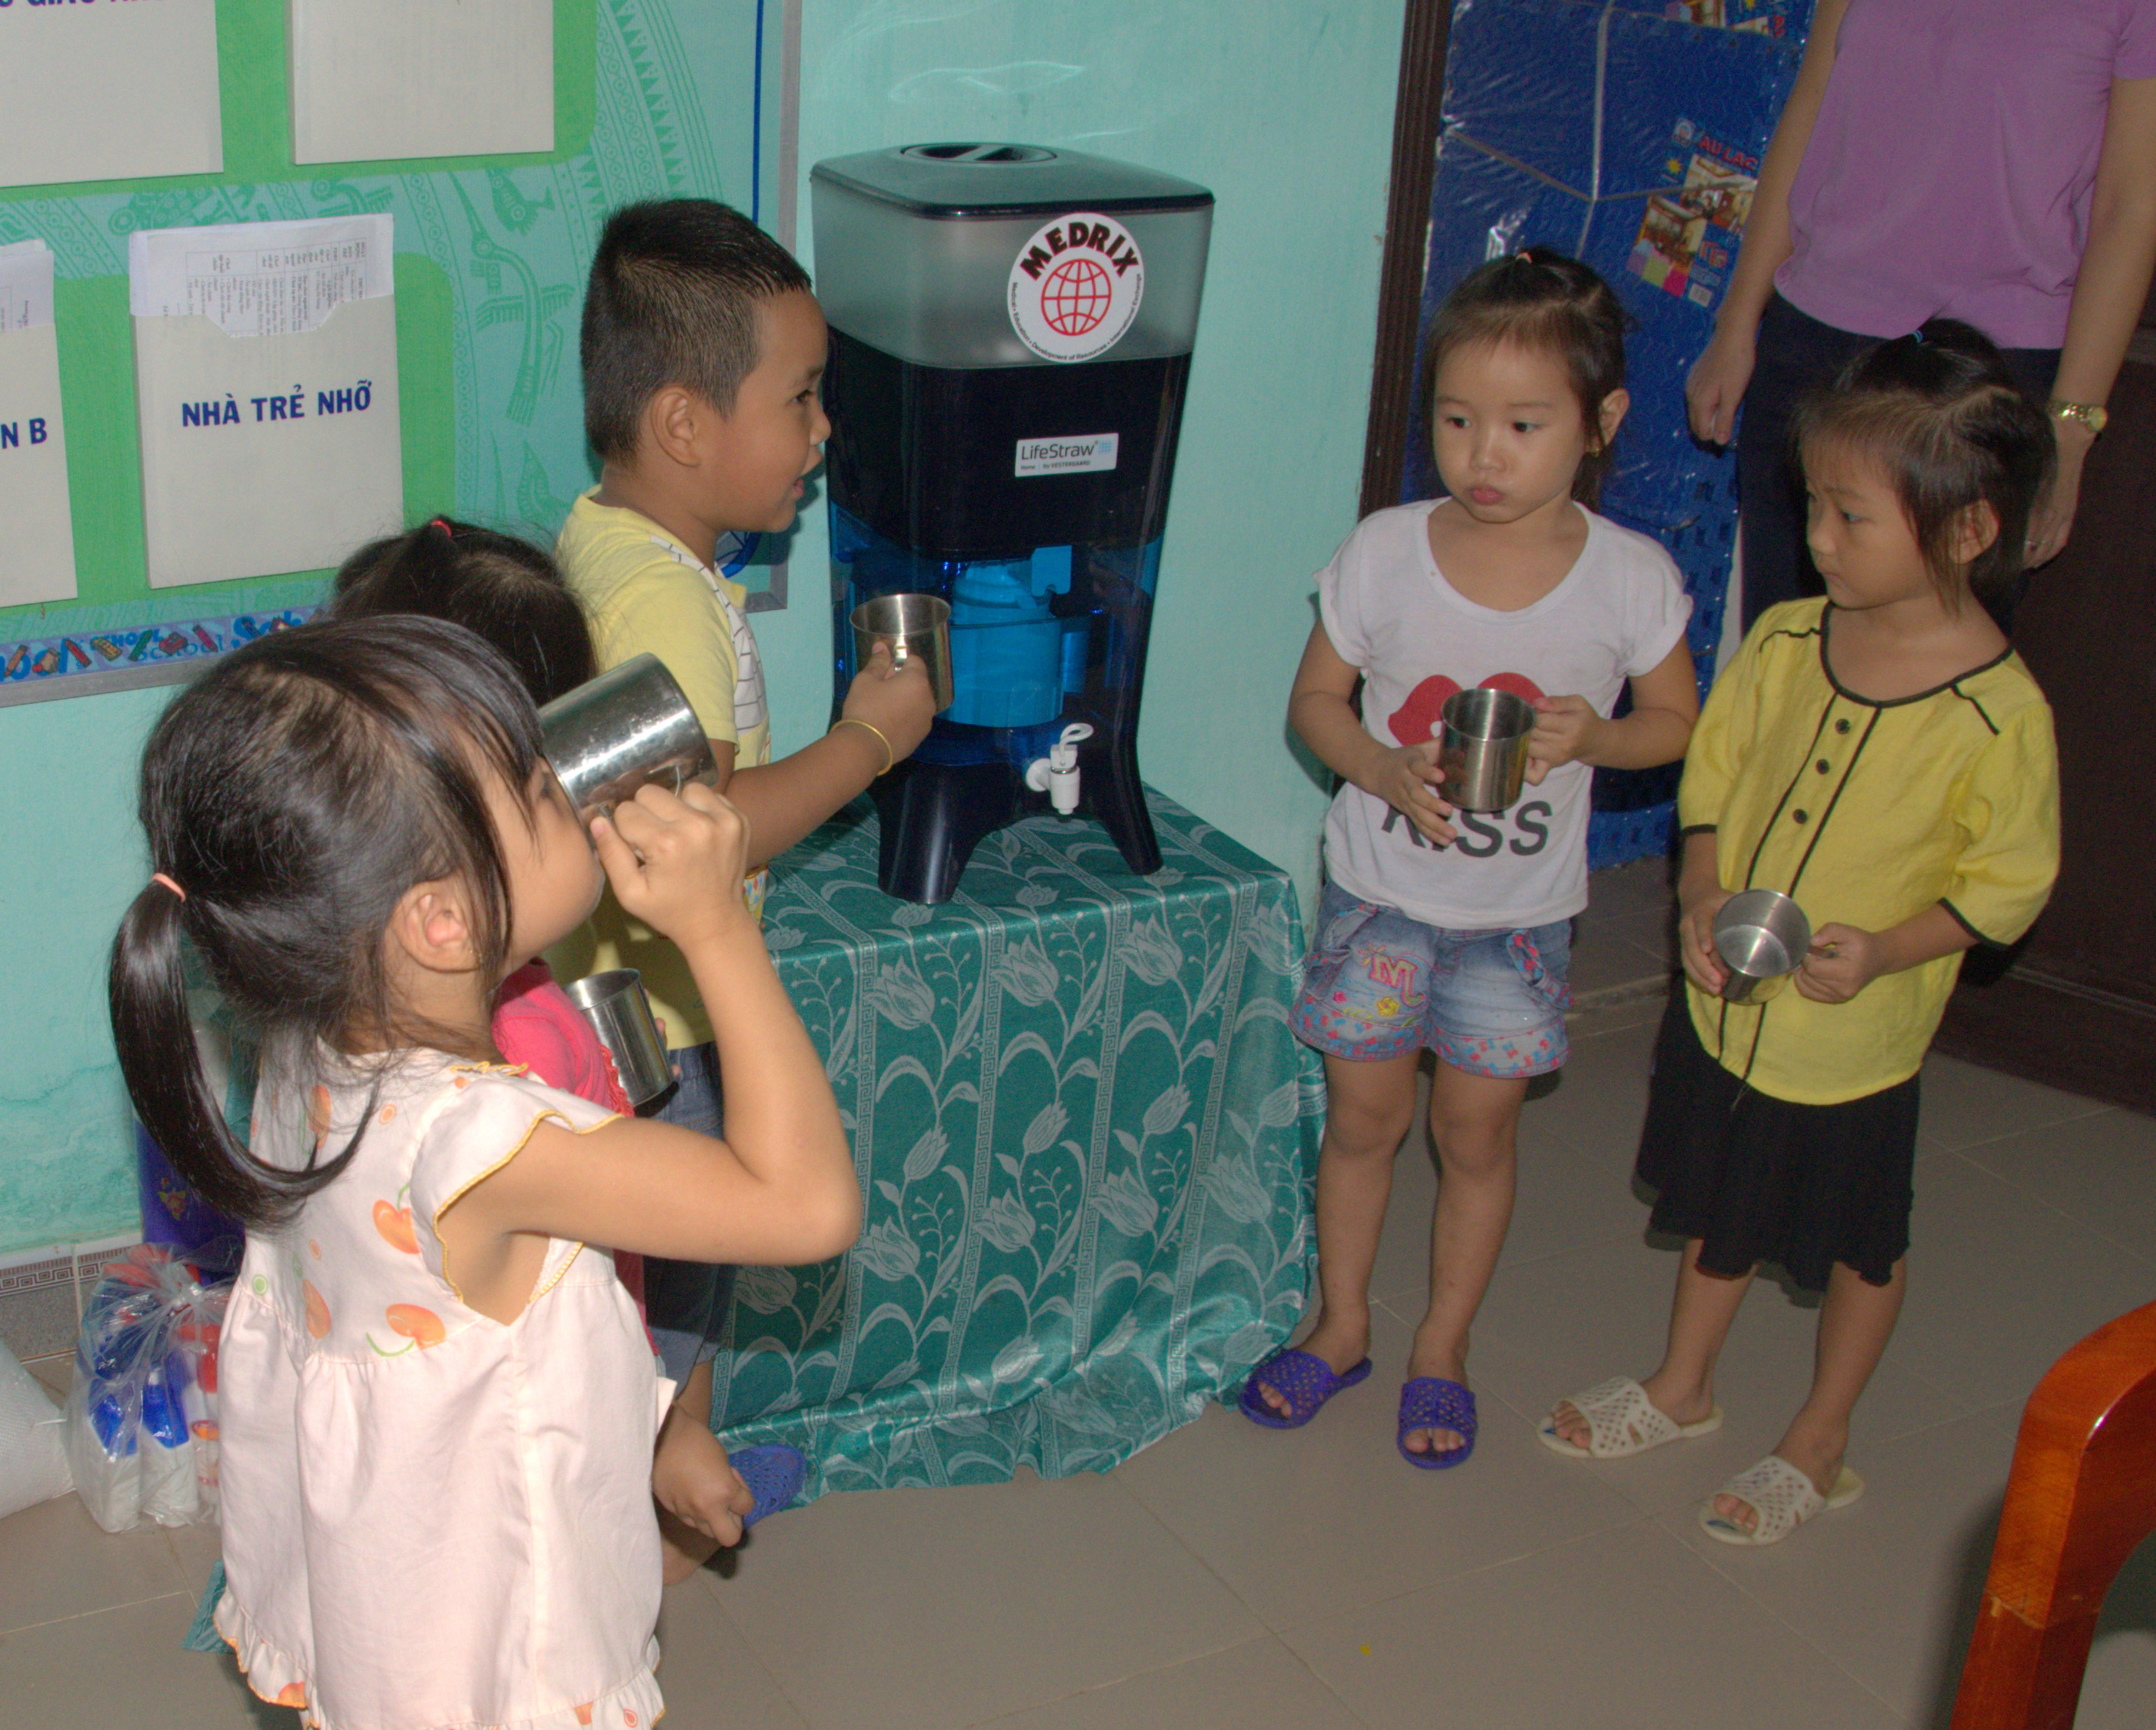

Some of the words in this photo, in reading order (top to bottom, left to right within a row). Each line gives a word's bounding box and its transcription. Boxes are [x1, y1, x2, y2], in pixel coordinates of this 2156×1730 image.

[1019, 222, 1139, 281] MEDRIX
[1014, 312, 1030, 342] Education
[1032, 342, 1067, 361] Development
[1077, 344, 1107, 359] Resources
[1109, 306, 1136, 342] International
[182, 393, 241, 427] NHÀ
[251, 384, 305, 422] TRẺ
[318, 379, 372, 416] NHỠ
[29, 417, 47, 444] B
